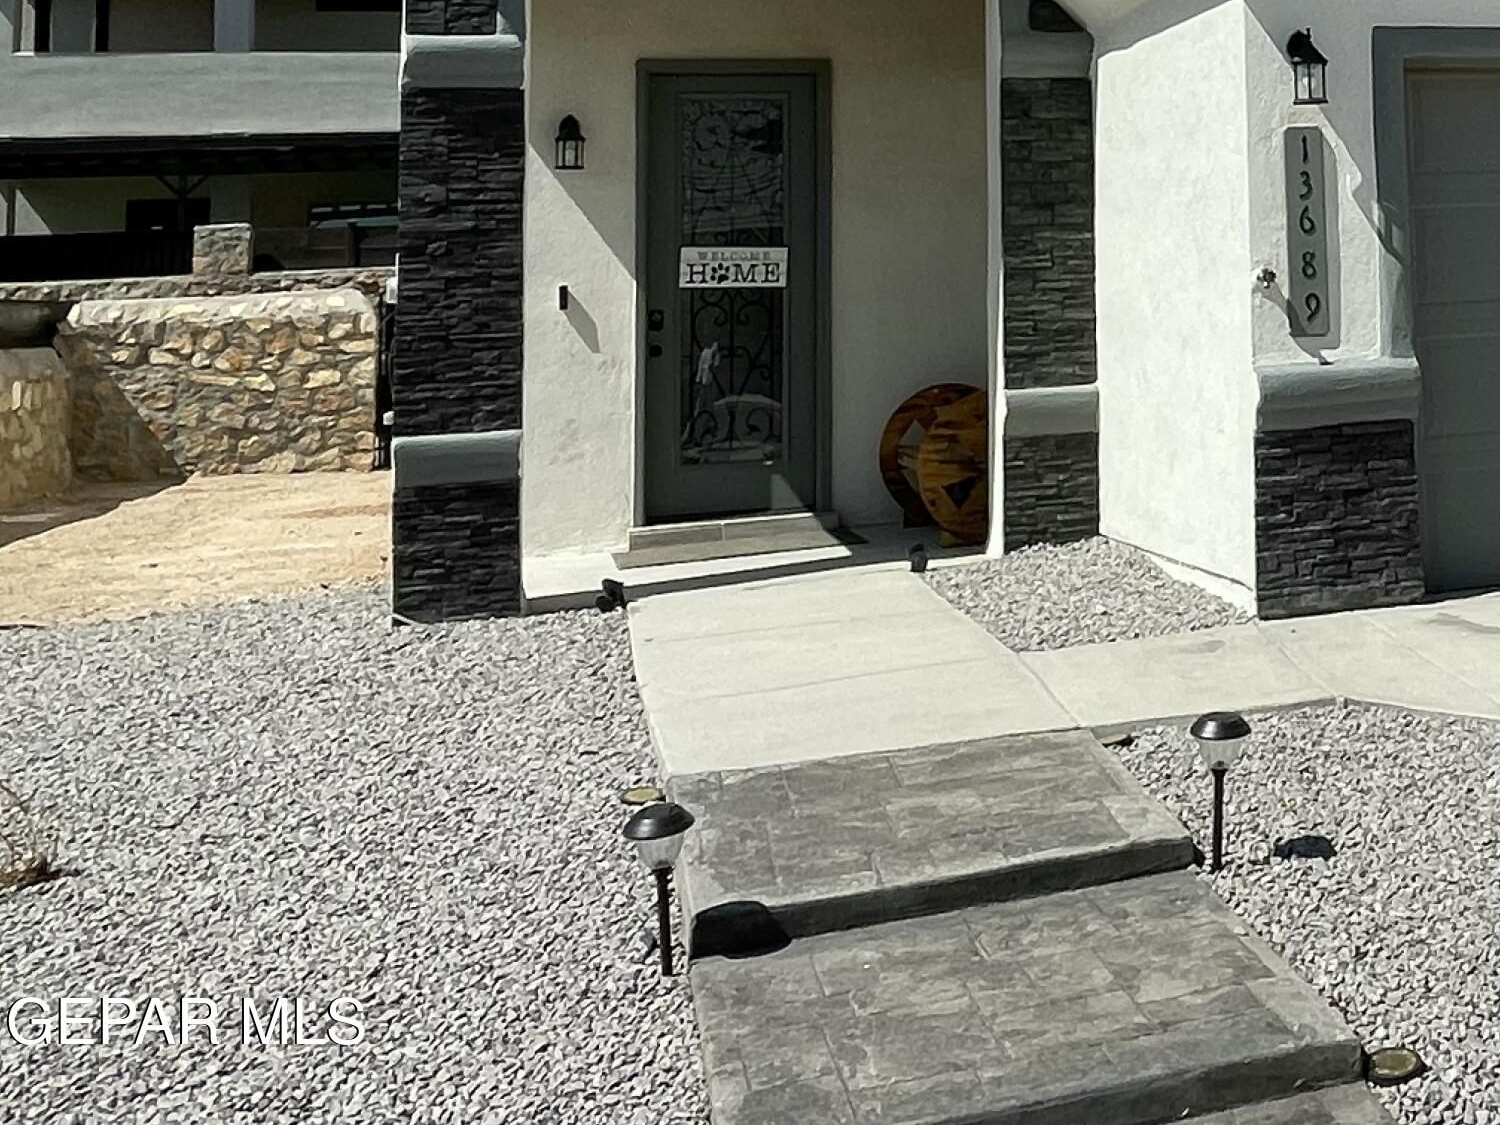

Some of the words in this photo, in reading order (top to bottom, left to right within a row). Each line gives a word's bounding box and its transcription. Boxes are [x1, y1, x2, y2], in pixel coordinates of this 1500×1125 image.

[1299, 134, 1321, 323] 13689
[698, 251, 771, 261] WELCOME
[685, 262, 780, 284] HME
